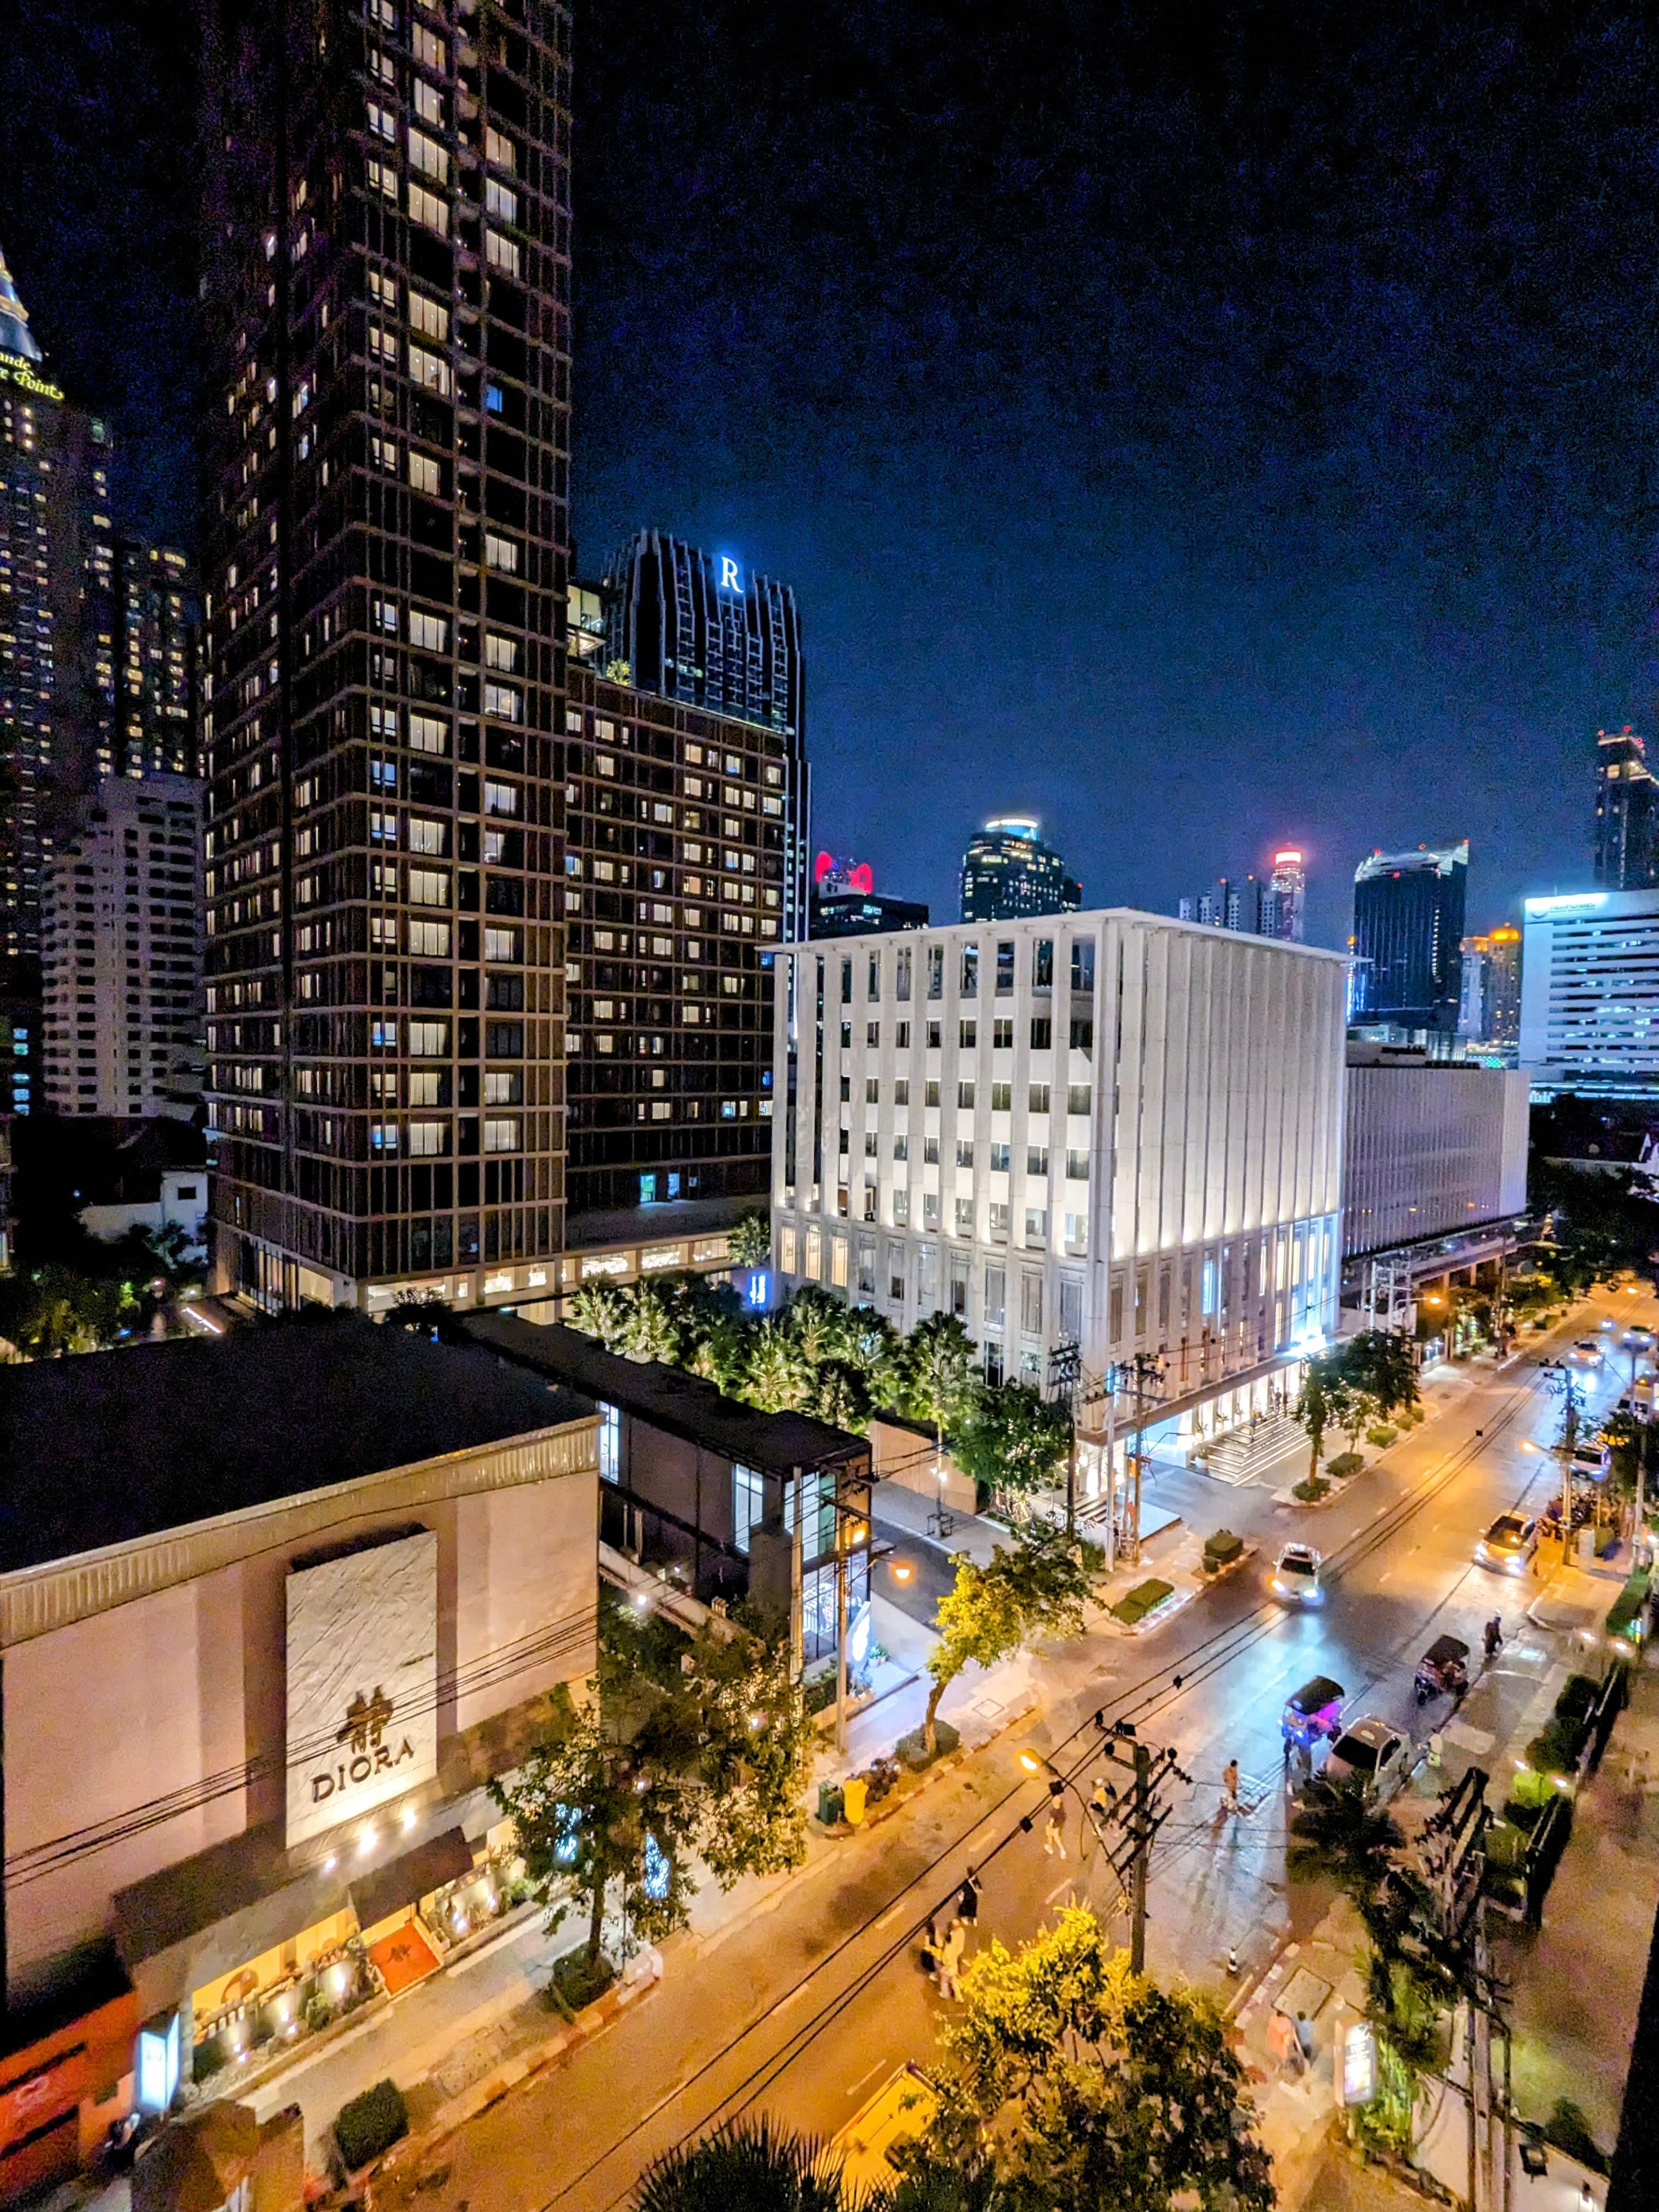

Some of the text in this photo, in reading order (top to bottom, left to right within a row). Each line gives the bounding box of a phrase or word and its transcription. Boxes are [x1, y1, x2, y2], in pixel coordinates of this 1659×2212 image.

[13, 370, 65, 399] Point
[720, 556, 744, 593] R
[310, 1735, 415, 1803] DIORA
